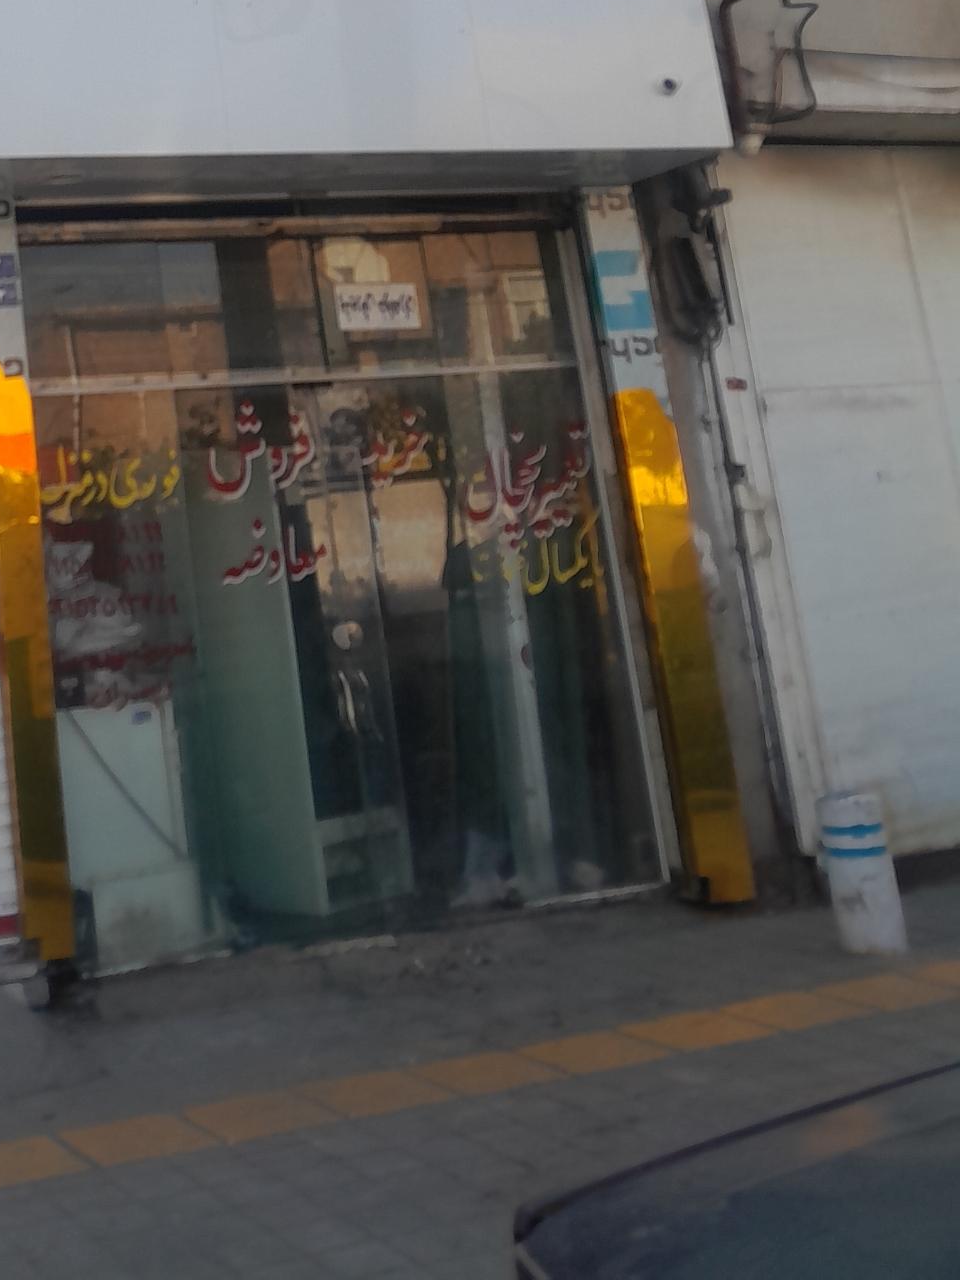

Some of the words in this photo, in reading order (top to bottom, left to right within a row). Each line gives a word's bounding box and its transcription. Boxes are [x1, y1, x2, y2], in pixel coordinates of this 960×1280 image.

[109, 451, 180, 509] فوری
[207, 401, 315, 500] فروش
[222, 518, 327, 586] معاوضه
